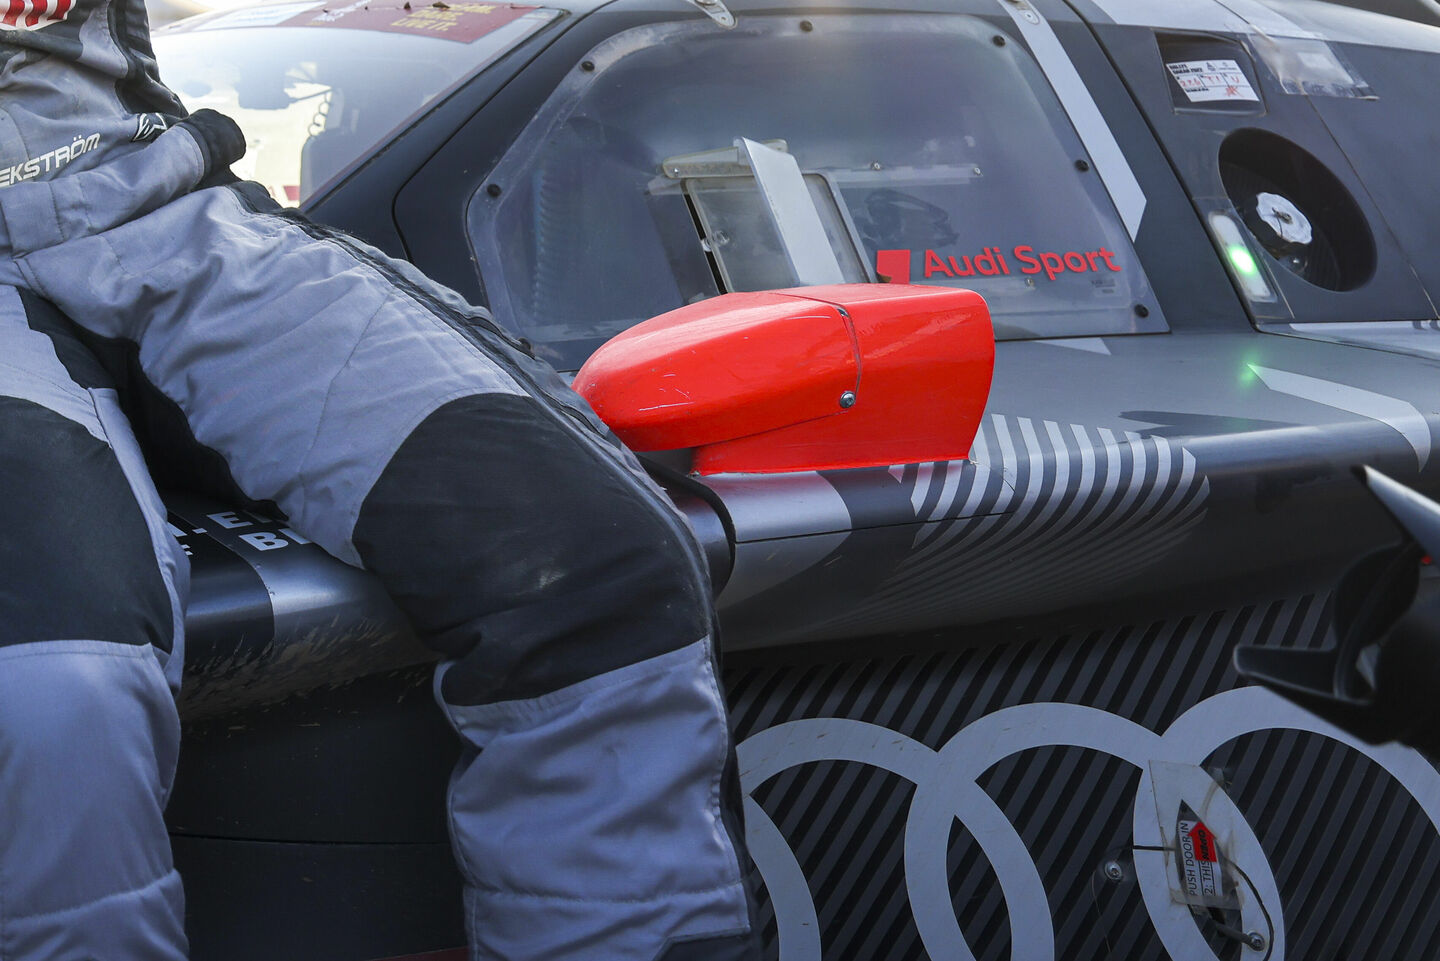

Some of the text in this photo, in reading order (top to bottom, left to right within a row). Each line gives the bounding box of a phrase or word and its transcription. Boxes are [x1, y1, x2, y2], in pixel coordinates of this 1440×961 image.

[924, 245, 1122, 281] Audi Sport
[1180, 822, 1198, 896] PUSH DOOR IN
